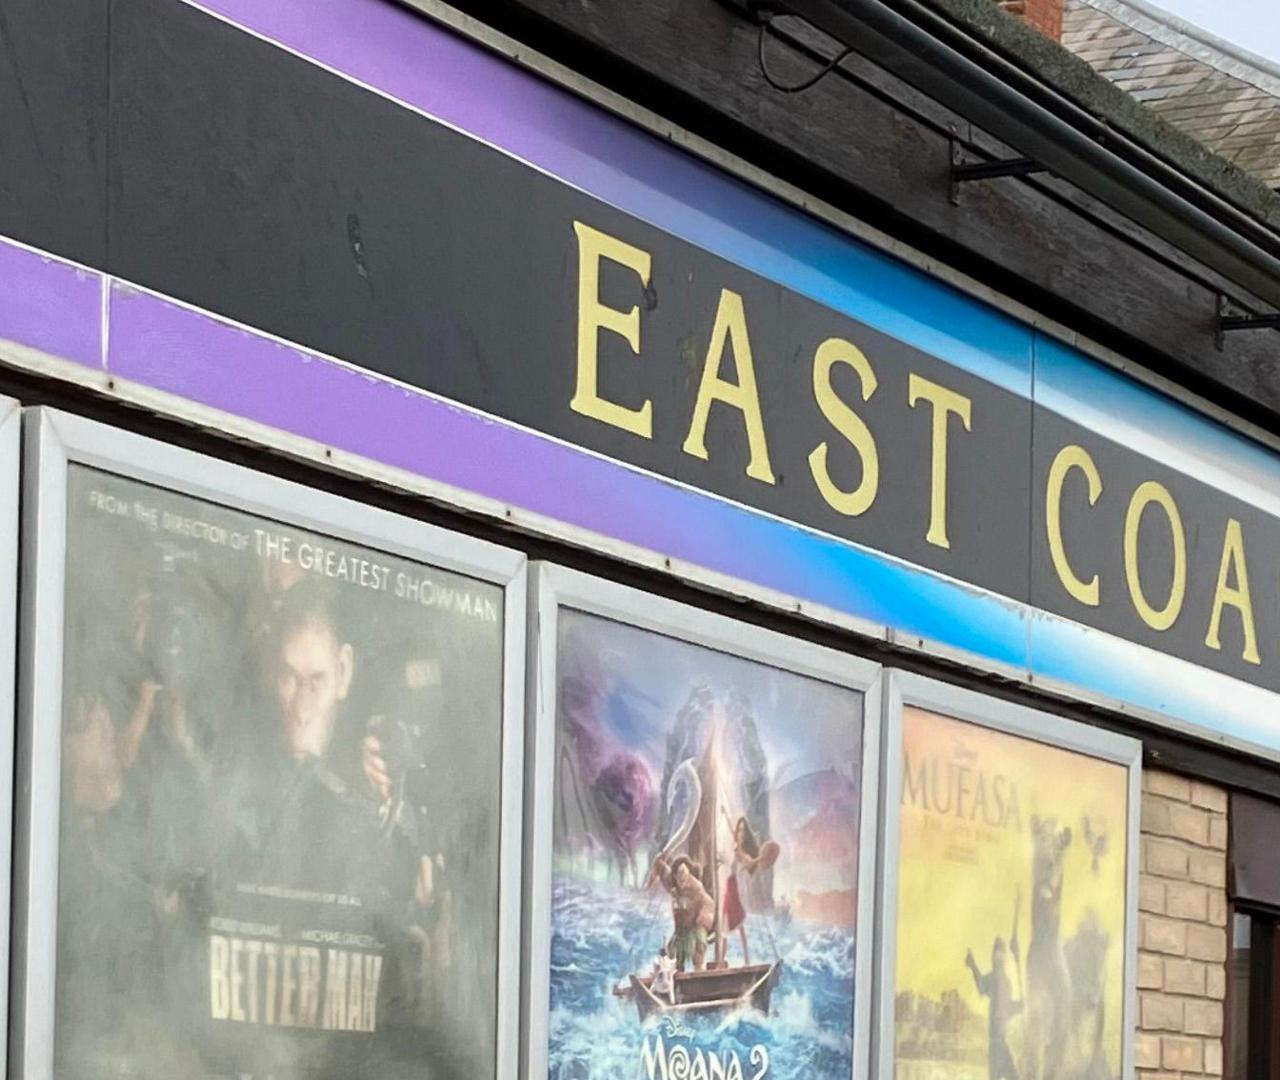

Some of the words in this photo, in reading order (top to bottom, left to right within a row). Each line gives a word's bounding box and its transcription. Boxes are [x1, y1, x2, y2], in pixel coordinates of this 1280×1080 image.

[570, 220, 971, 550] EAST
[89, 491, 128, 515] FROM
[163, 512, 227, 545] DIRECTOR
[231, 532, 249, 549] OF
[254, 529, 291, 564] THE
[298, 545, 391, 590] GREATEST
[395, 575, 497, 622] SHOWMAN
[900, 751, 1022, 832] MUFASA
[210, 935, 320, 1028] BETTER
[322, 949, 382, 1032] MAN
